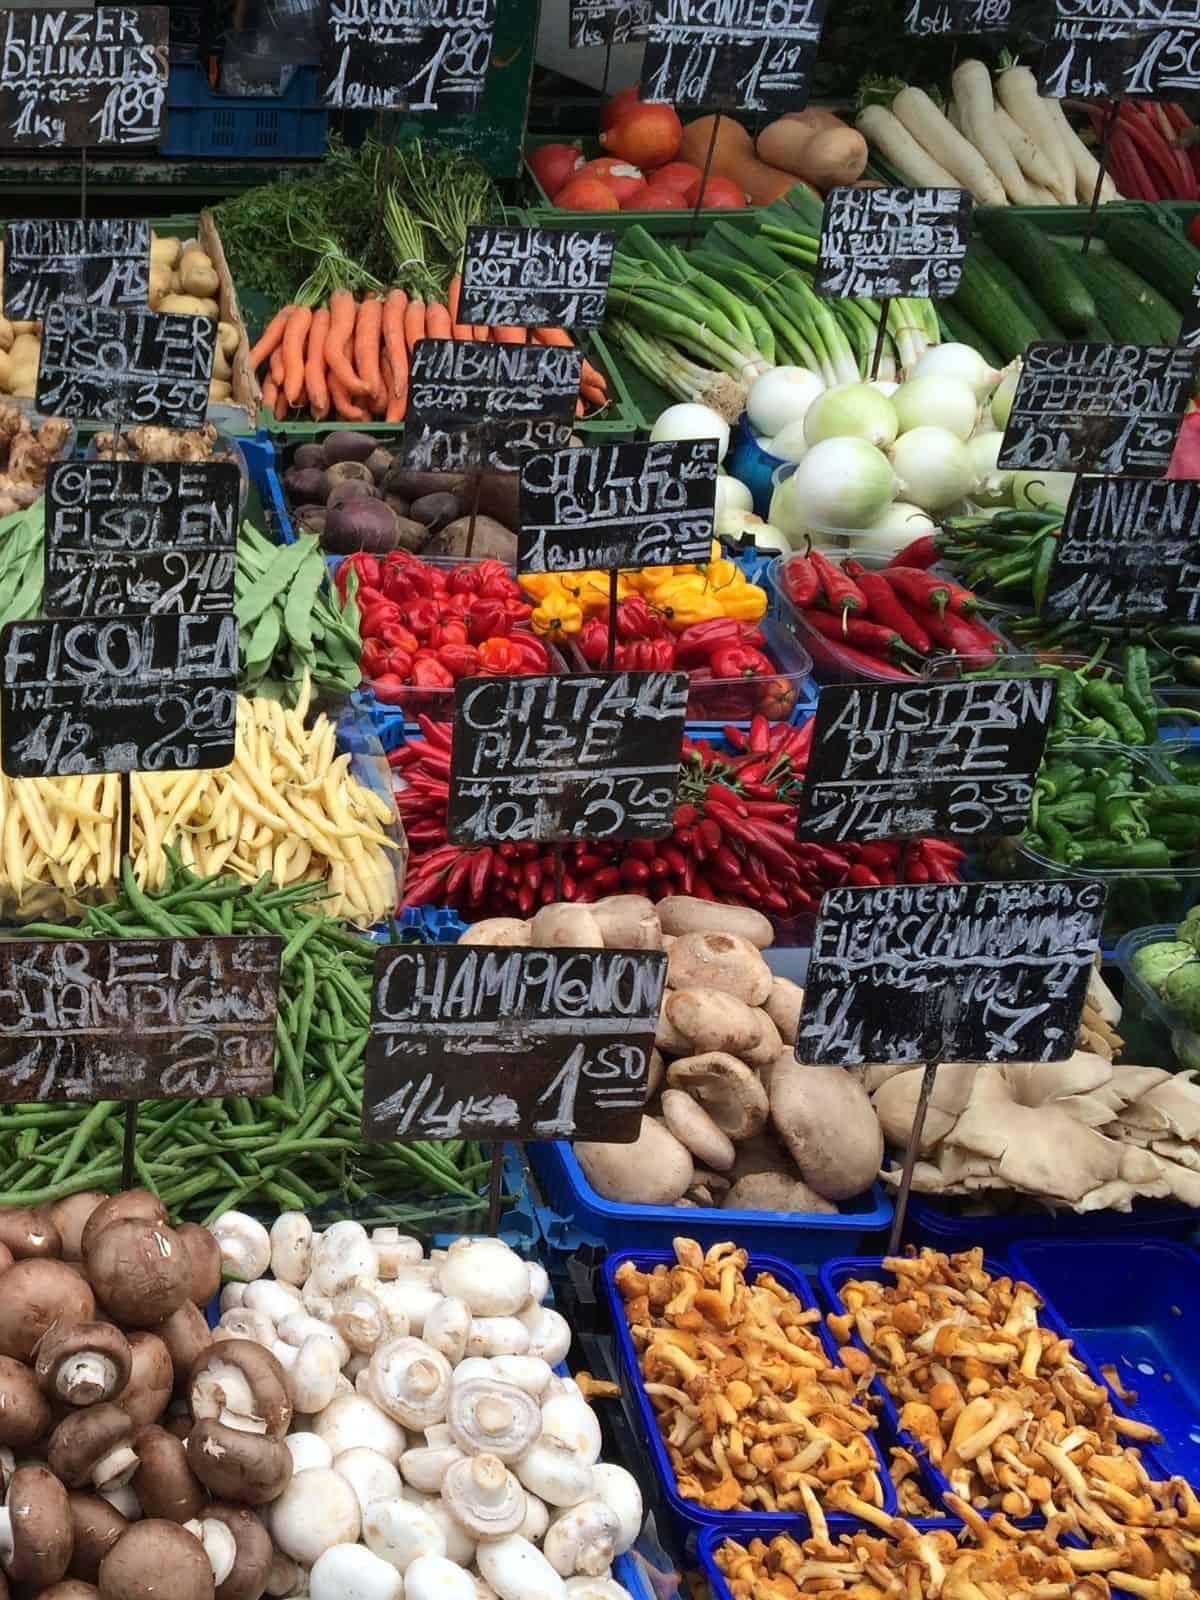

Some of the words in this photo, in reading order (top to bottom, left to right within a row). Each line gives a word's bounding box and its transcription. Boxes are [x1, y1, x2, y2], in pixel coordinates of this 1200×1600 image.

[5, 7, 143, 46] LINZER
[1, 44, 169, 82] DELIKATESS
[1027, 344, 1196, 378] SCHARFE
[51, 462, 206, 506] GELBE
[49, 501, 236, 546] FISOLEN
[3, 615, 238, 684] FISOLEN
[821, 679, 1052, 744] AUSTERN
[841, 725, 1010, 778] PILZE
[377, 951, 669, 1021] CHAMPIGNON
